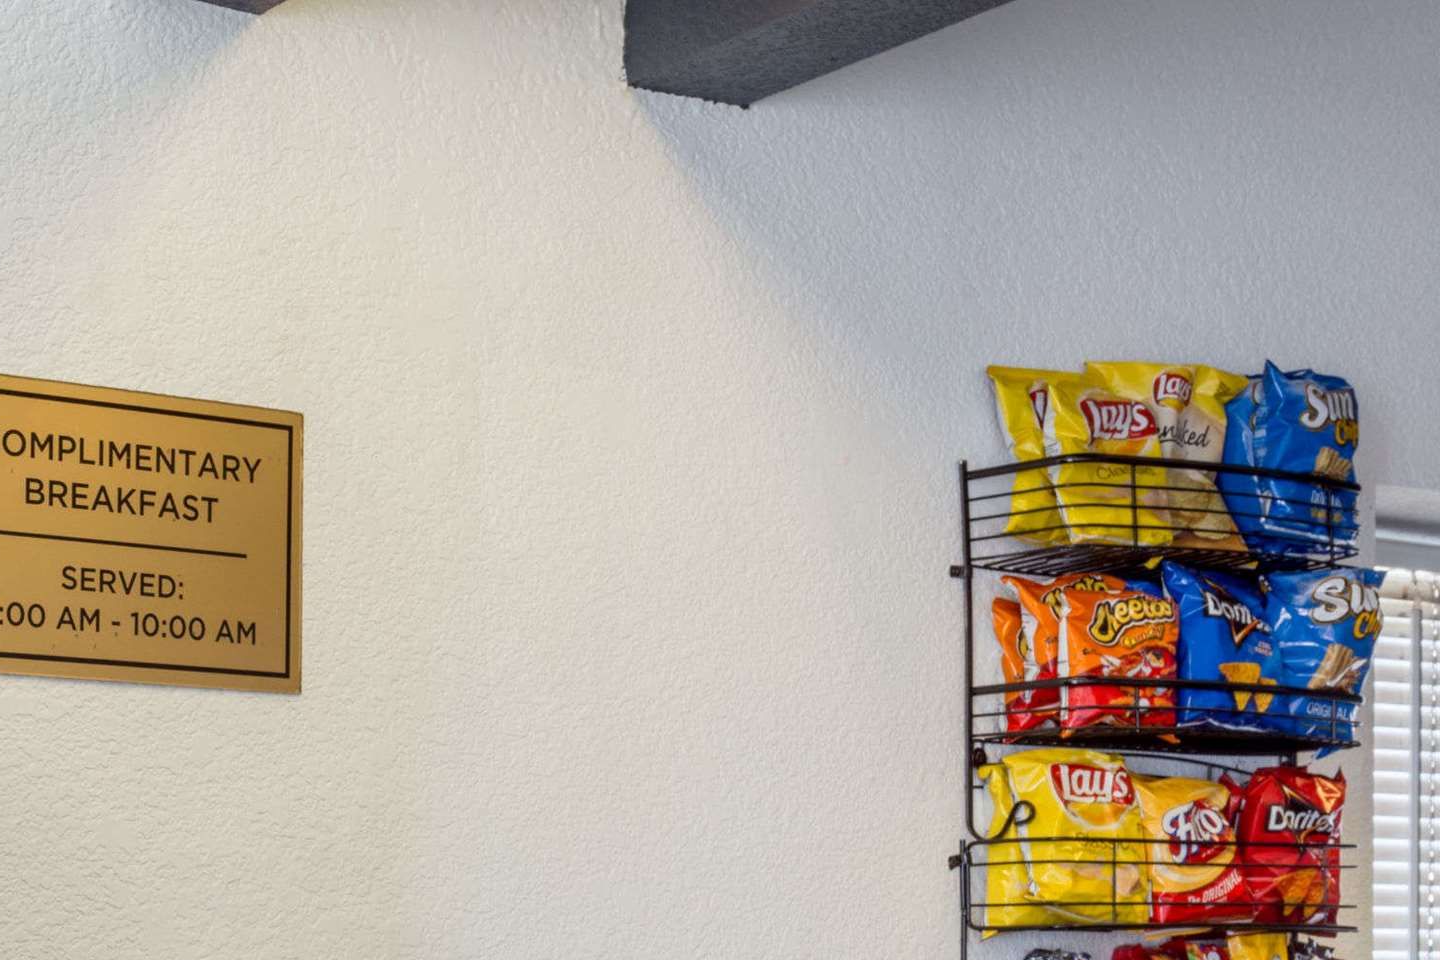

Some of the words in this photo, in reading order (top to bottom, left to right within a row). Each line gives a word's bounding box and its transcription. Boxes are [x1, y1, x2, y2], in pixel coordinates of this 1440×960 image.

[24, 477, 219, 524] BREAKFAST
[61, 565, 184, 600] SERVED:
[56, 606, 101, 632] AM
[130, 612, 206, 641] 10:00
[215, 620, 257, 645] AM
[1090, 597, 1174, 643] Cheetos
[1307, 703, 1348, 718] ORIGIAL
